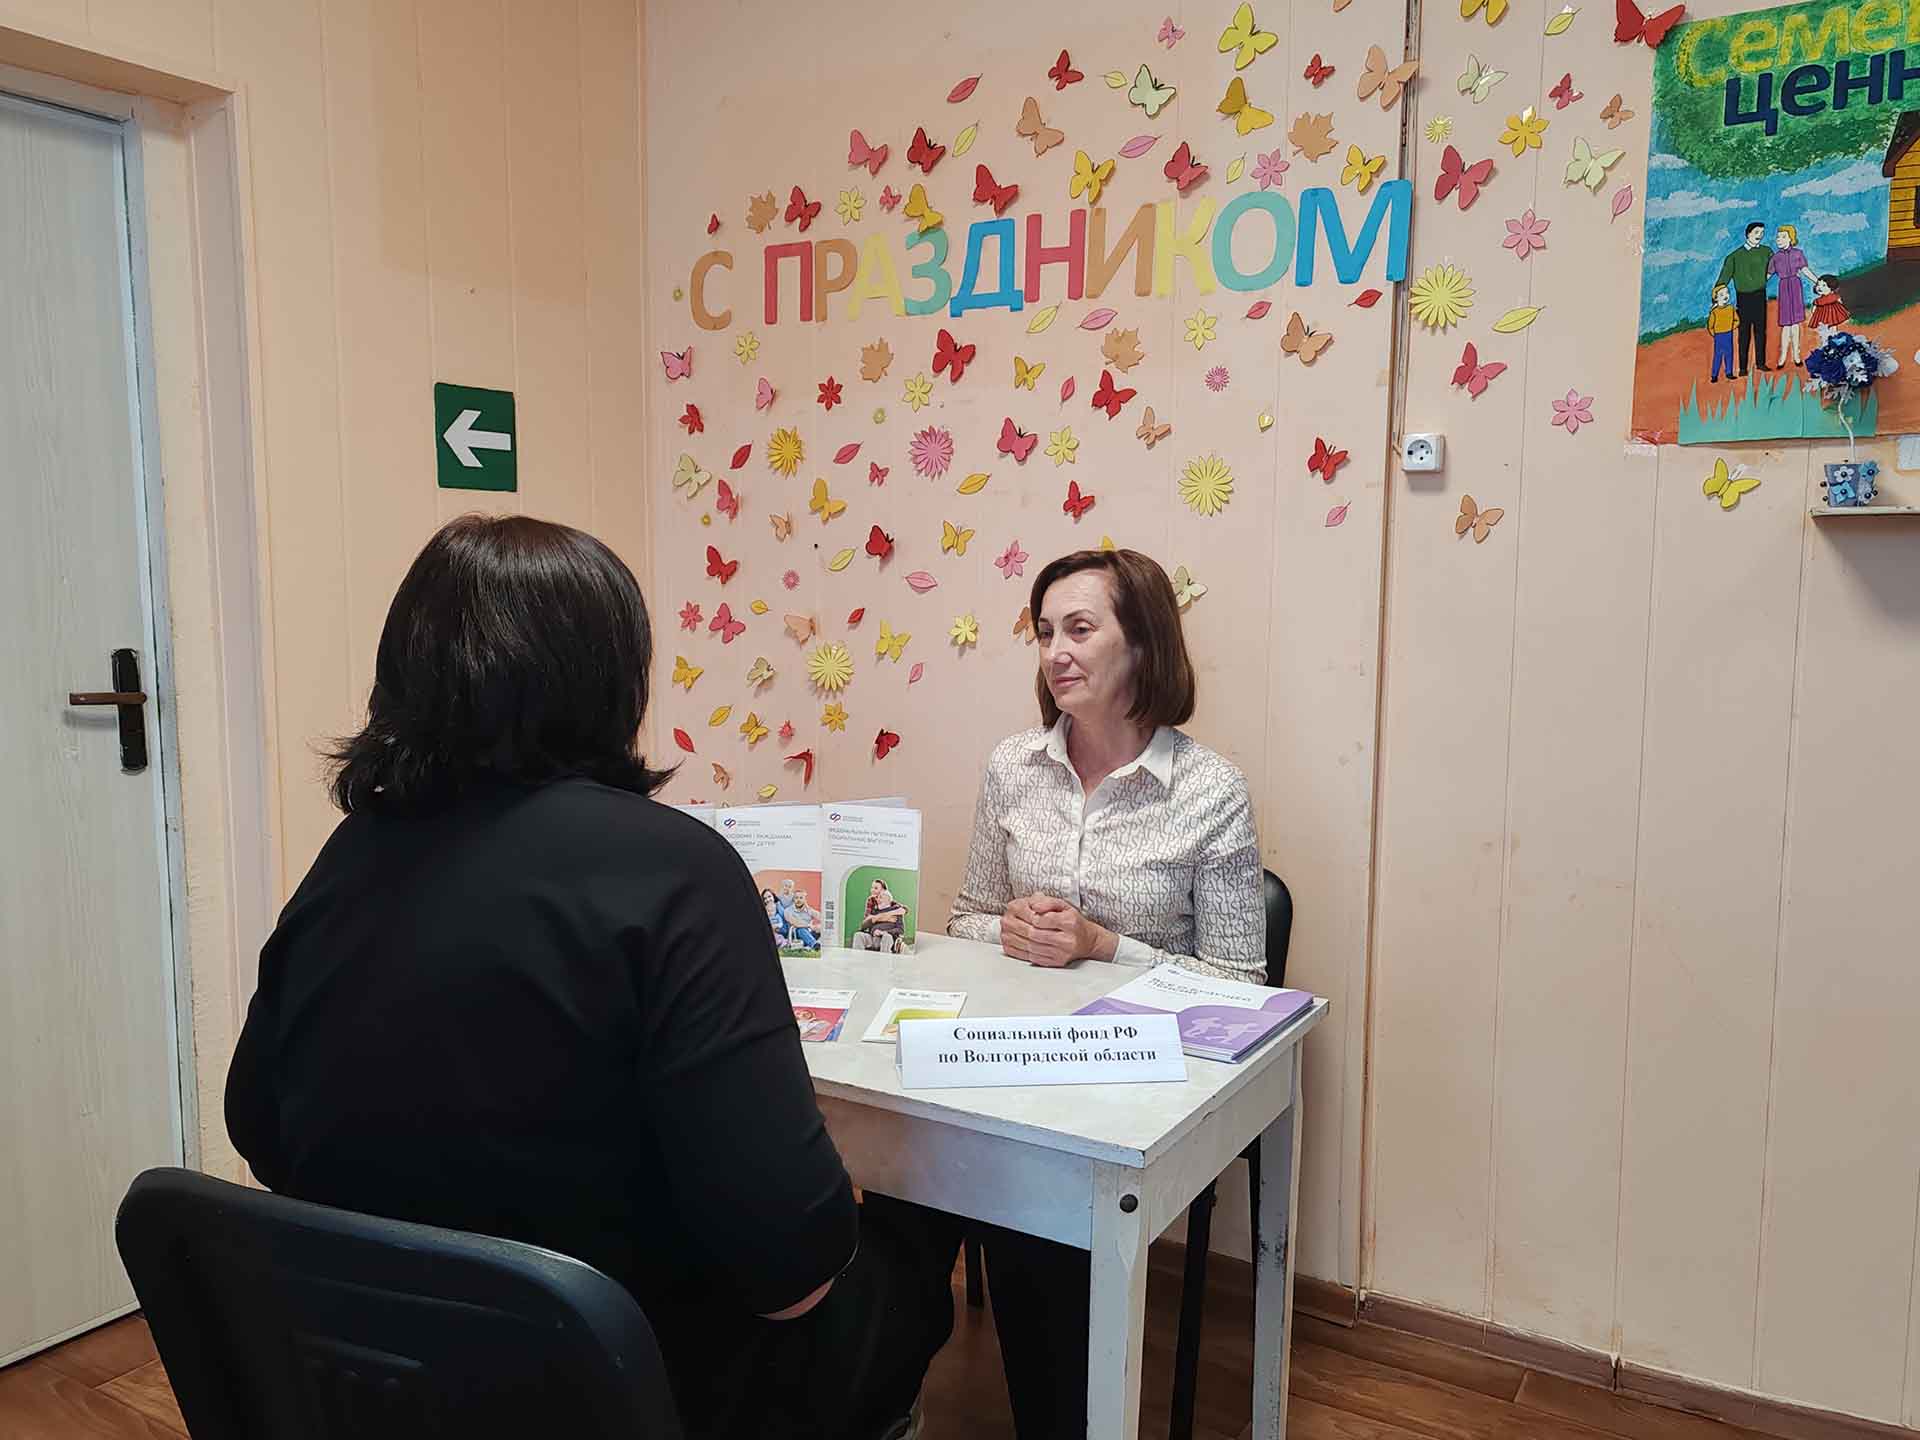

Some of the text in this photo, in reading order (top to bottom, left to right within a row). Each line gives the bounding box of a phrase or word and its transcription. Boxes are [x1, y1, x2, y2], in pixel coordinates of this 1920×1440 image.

[1676, 0, 1920, 88] Семе
[690, 178, 1413, 331] С ПРАЗДНИКОМ
[938, 1048, 1157, 1066] по Волгоградской области
[953, 1025, 1138, 1043] Социальный фонд РФ
